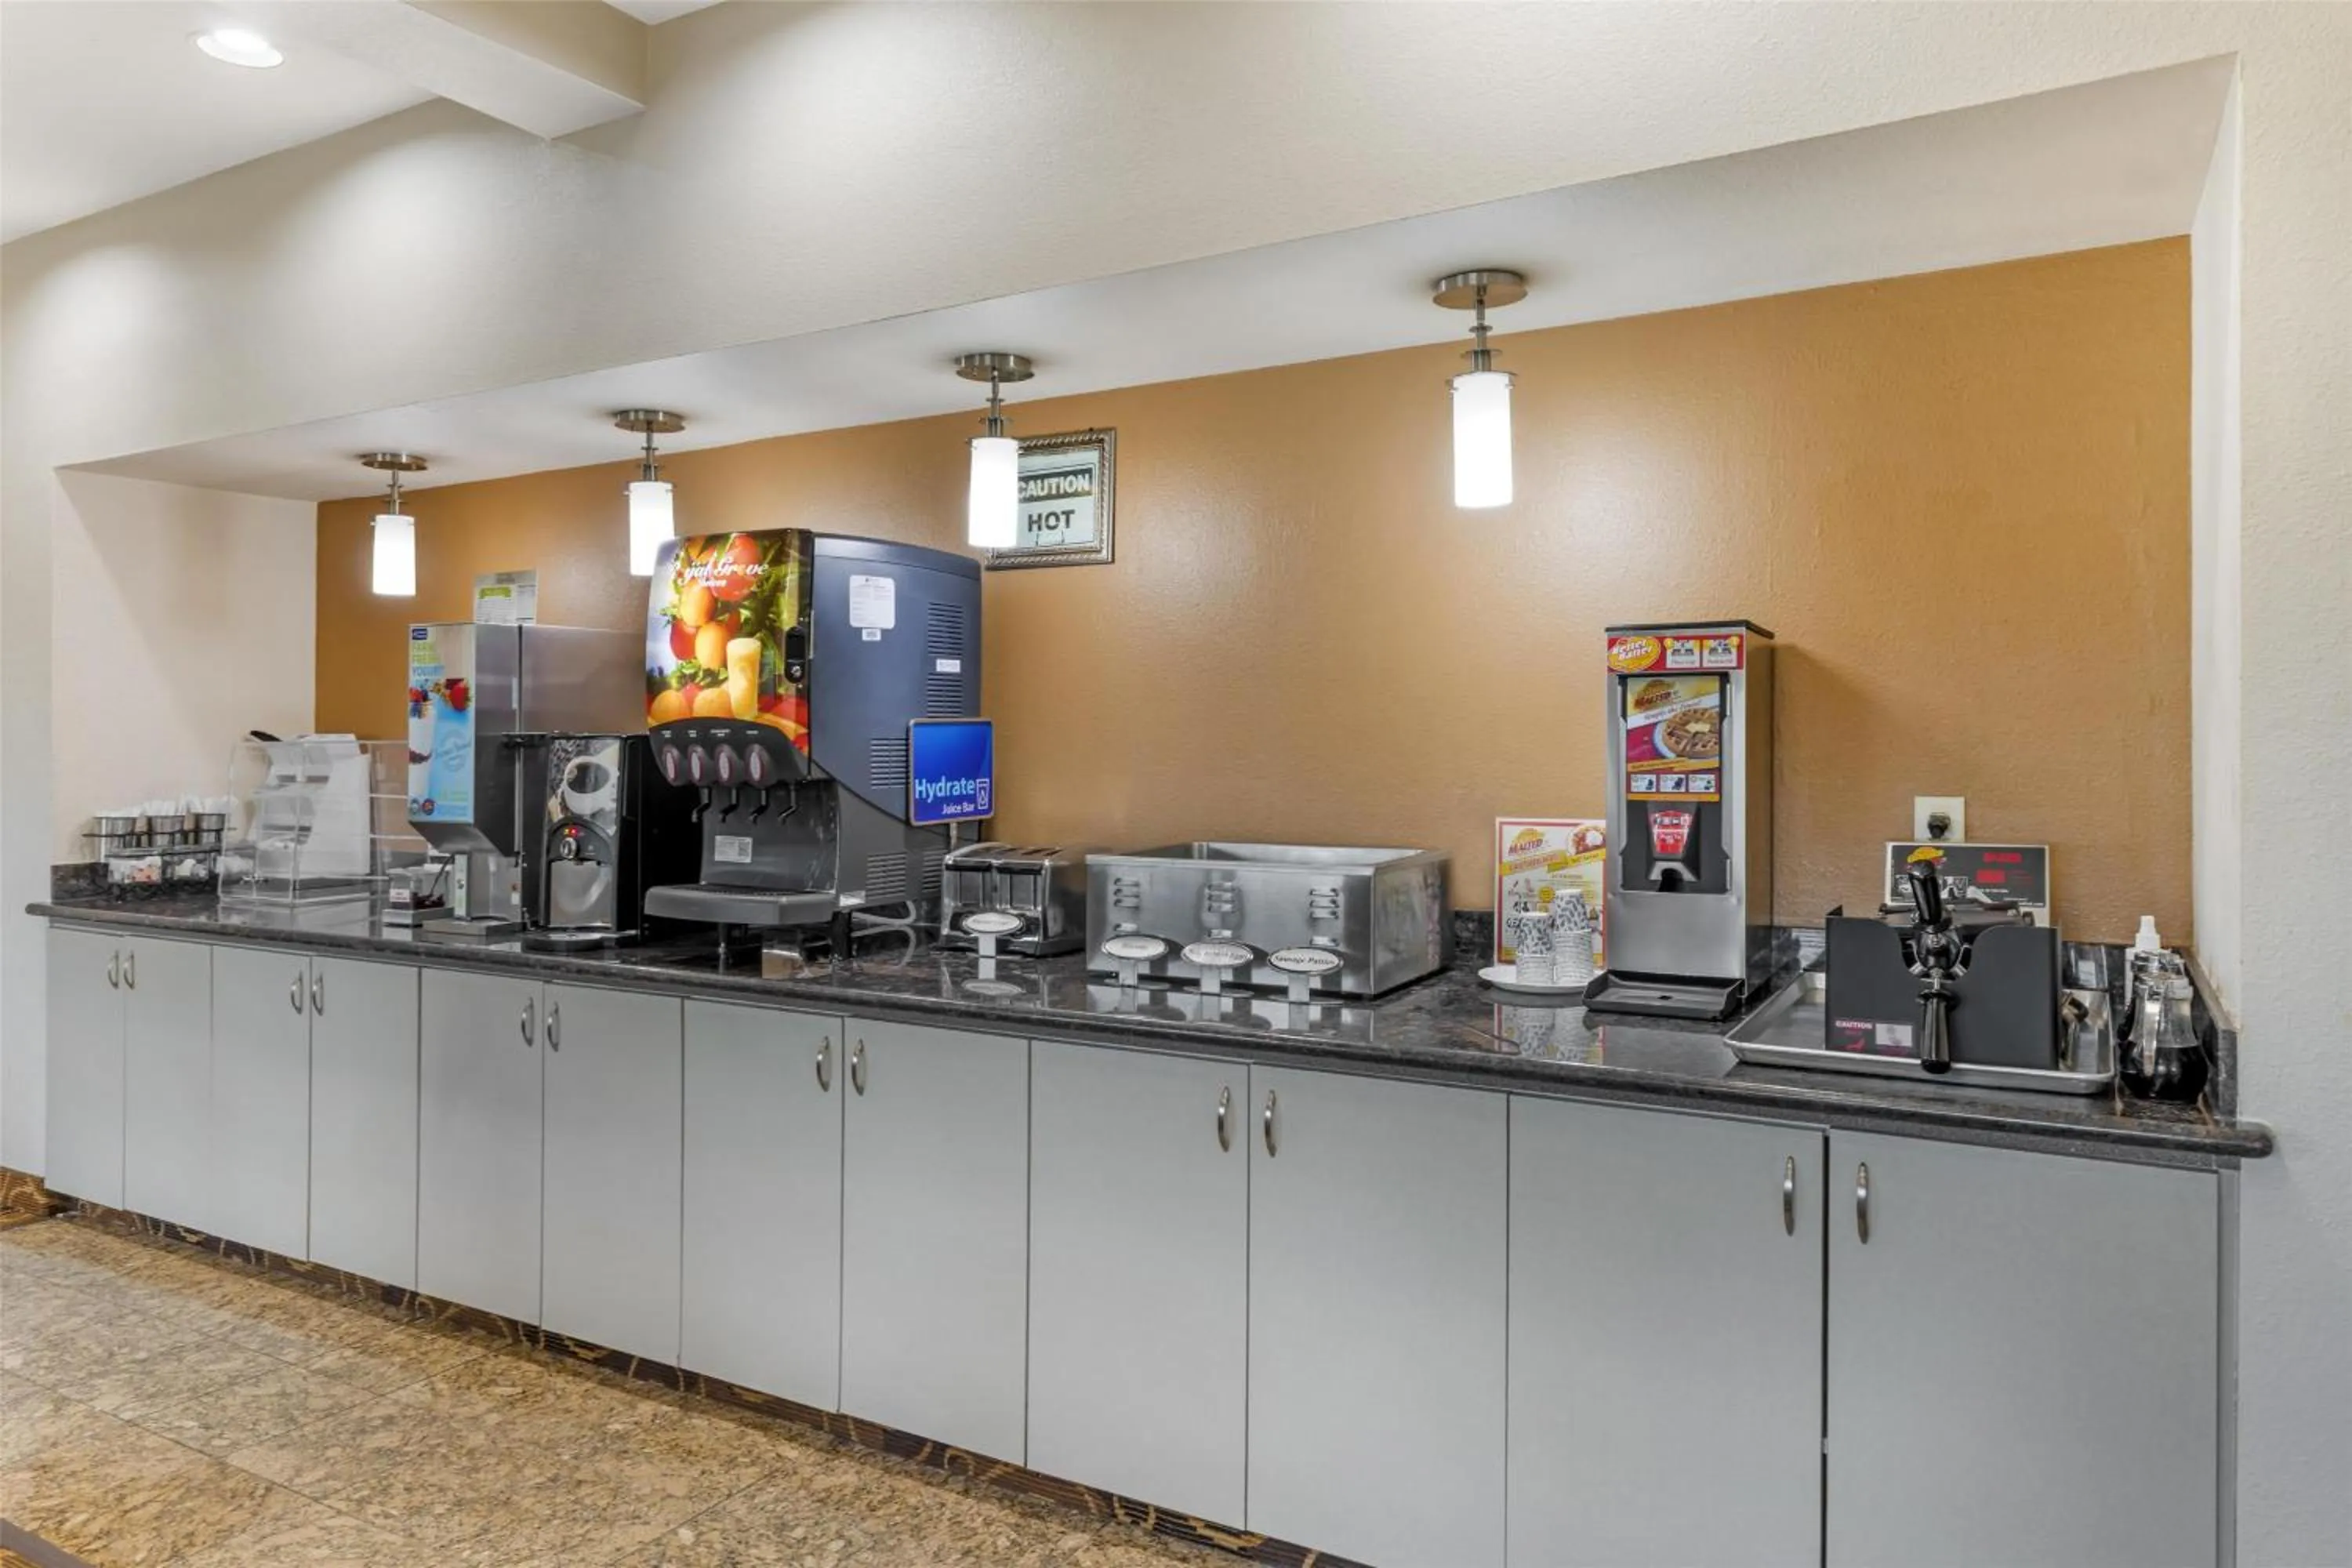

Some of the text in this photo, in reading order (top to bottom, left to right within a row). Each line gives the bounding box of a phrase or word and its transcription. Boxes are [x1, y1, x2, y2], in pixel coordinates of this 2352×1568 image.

[1018, 474, 1090, 499] CAUTION
[1027, 510, 1076, 532] HOT
[915, 775, 976, 803] Hydrate
[942, 802, 975, 815] Juice Bar
[1835, 1021, 1873, 1029] CAUTION
